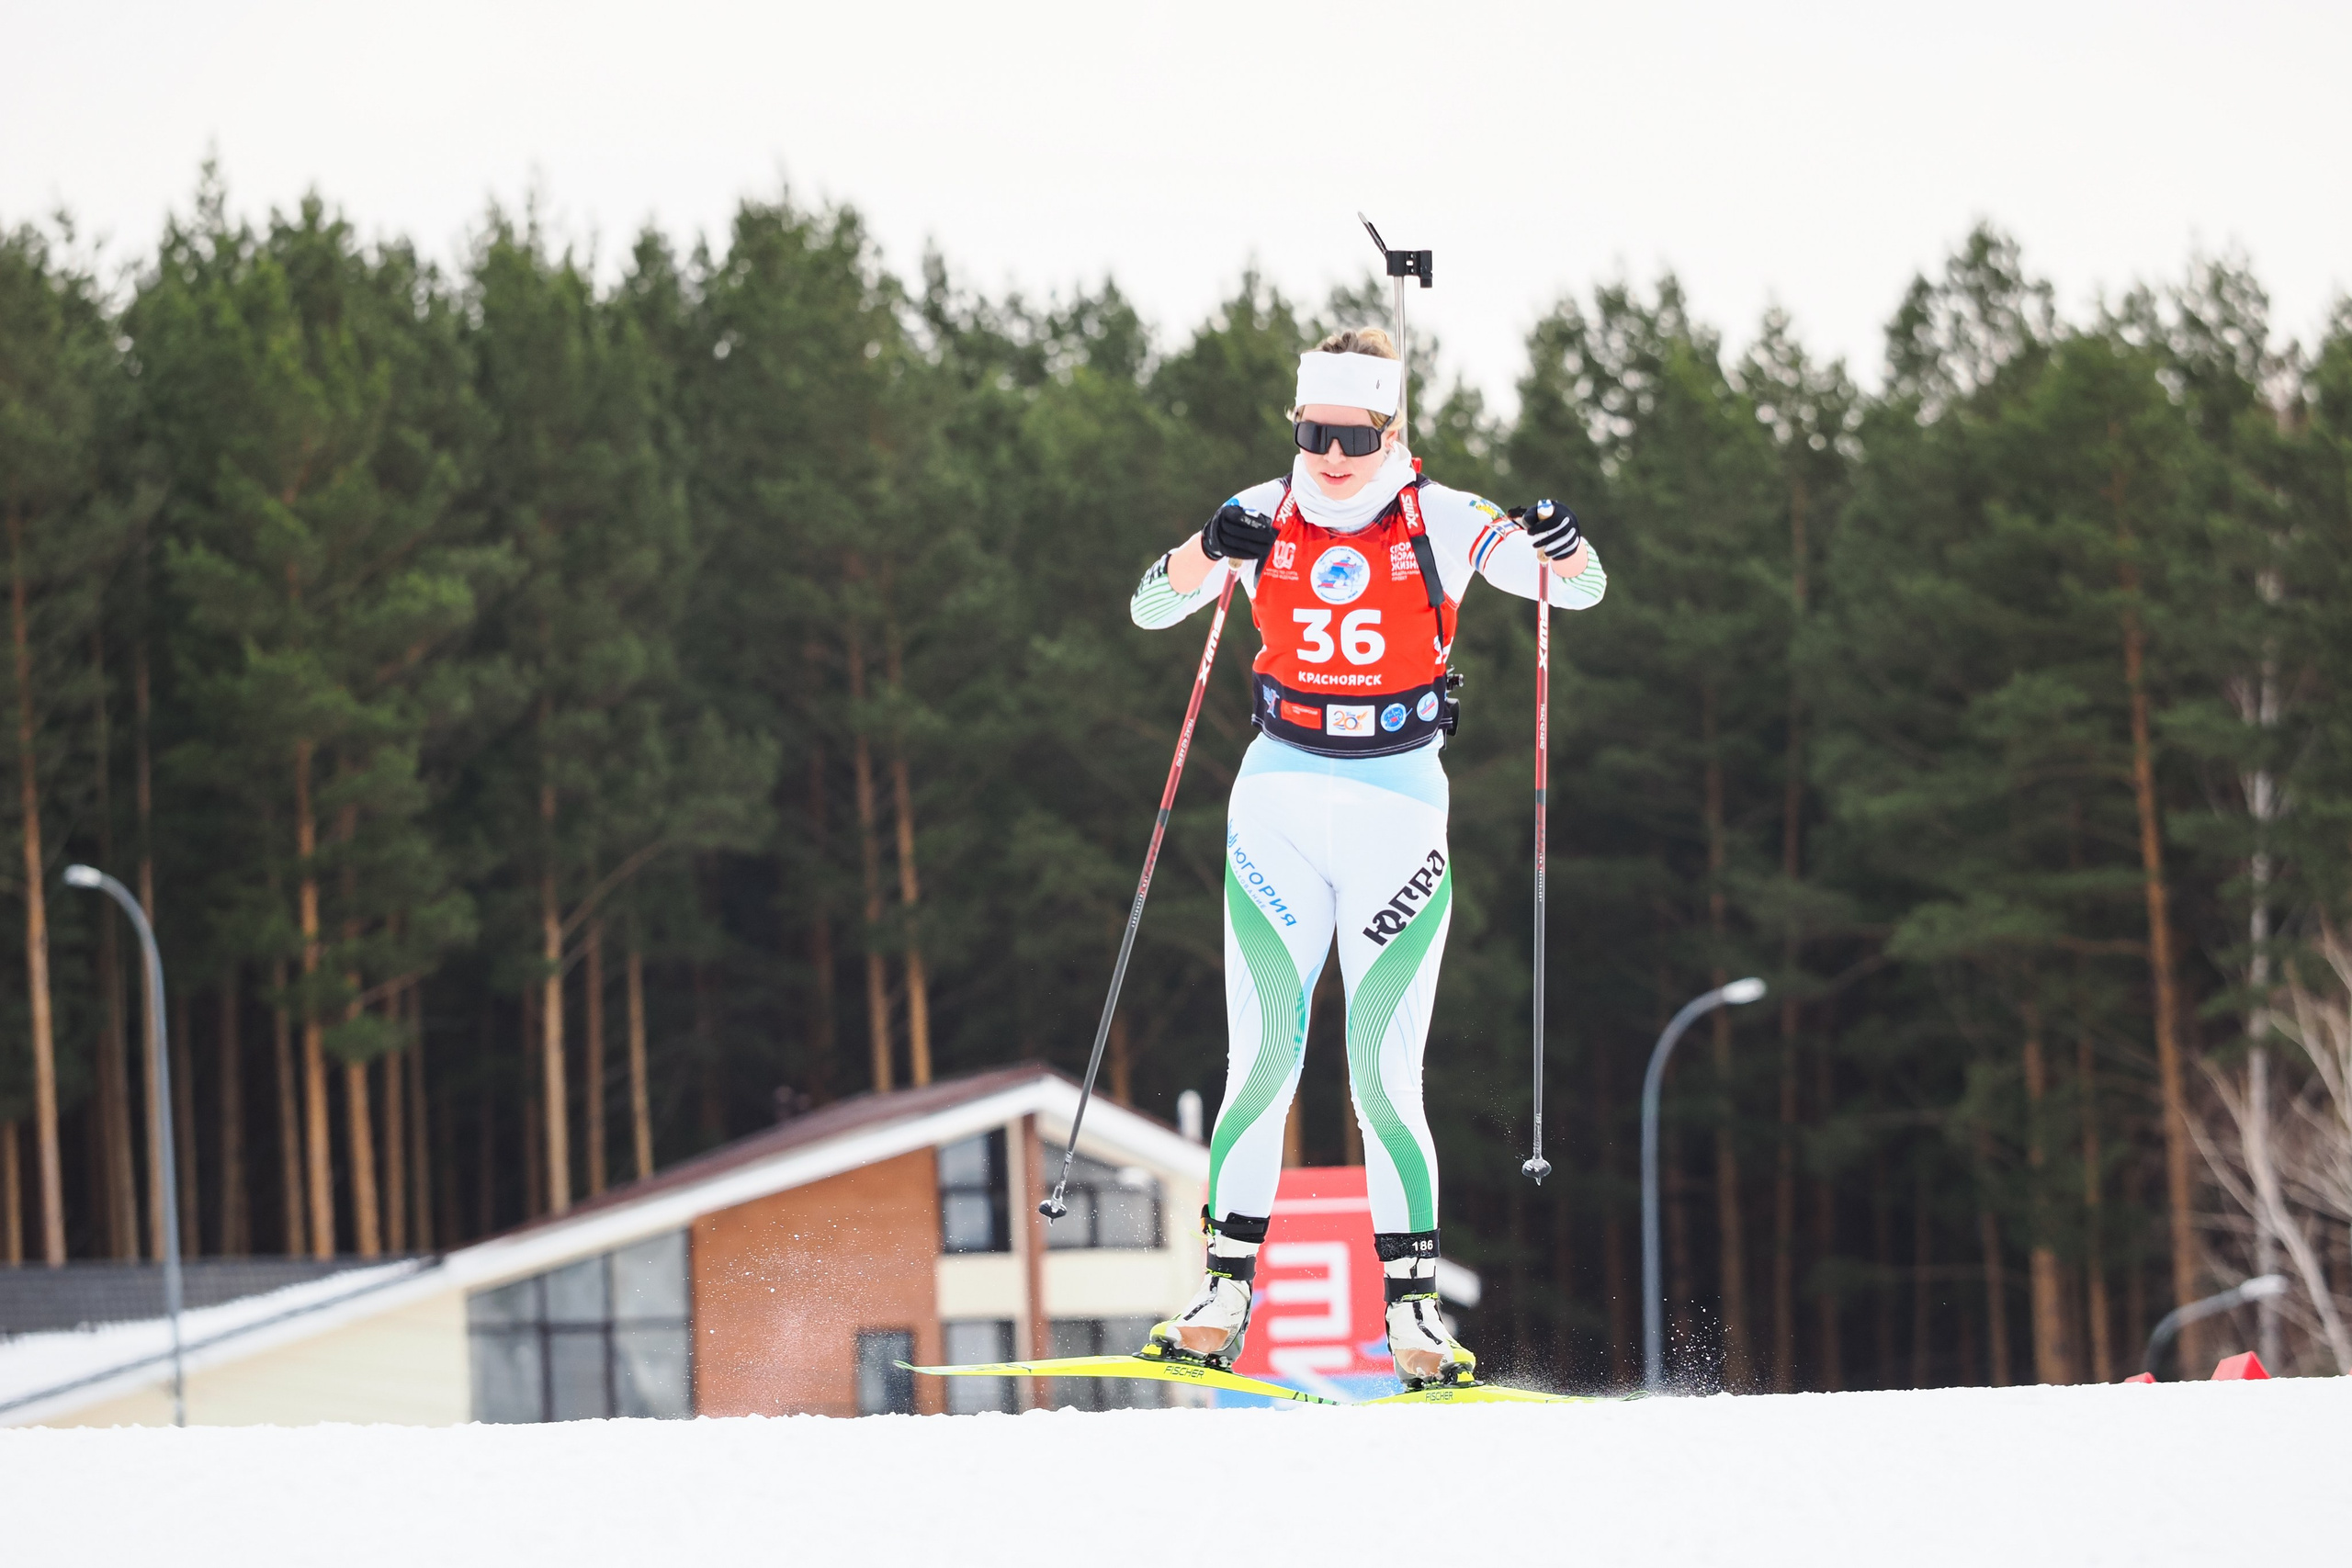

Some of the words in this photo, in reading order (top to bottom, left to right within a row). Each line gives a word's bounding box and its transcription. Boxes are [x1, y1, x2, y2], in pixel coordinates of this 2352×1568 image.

[1389, 542, 1412, 554] СПОР
[1390, 551, 1416, 562] НОРМ
[1293, 608, 1385, 666] 36
[1298, 671, 1382, 686] КРАСНОЯРСК
[1233, 847, 1297, 927] ЮГОРИЯ
[1411, 1239, 1433, 1252] 186
[1163, 1365, 1204, 1380] FISCHER
[1425, 1391, 1453, 1402] FISCHER
